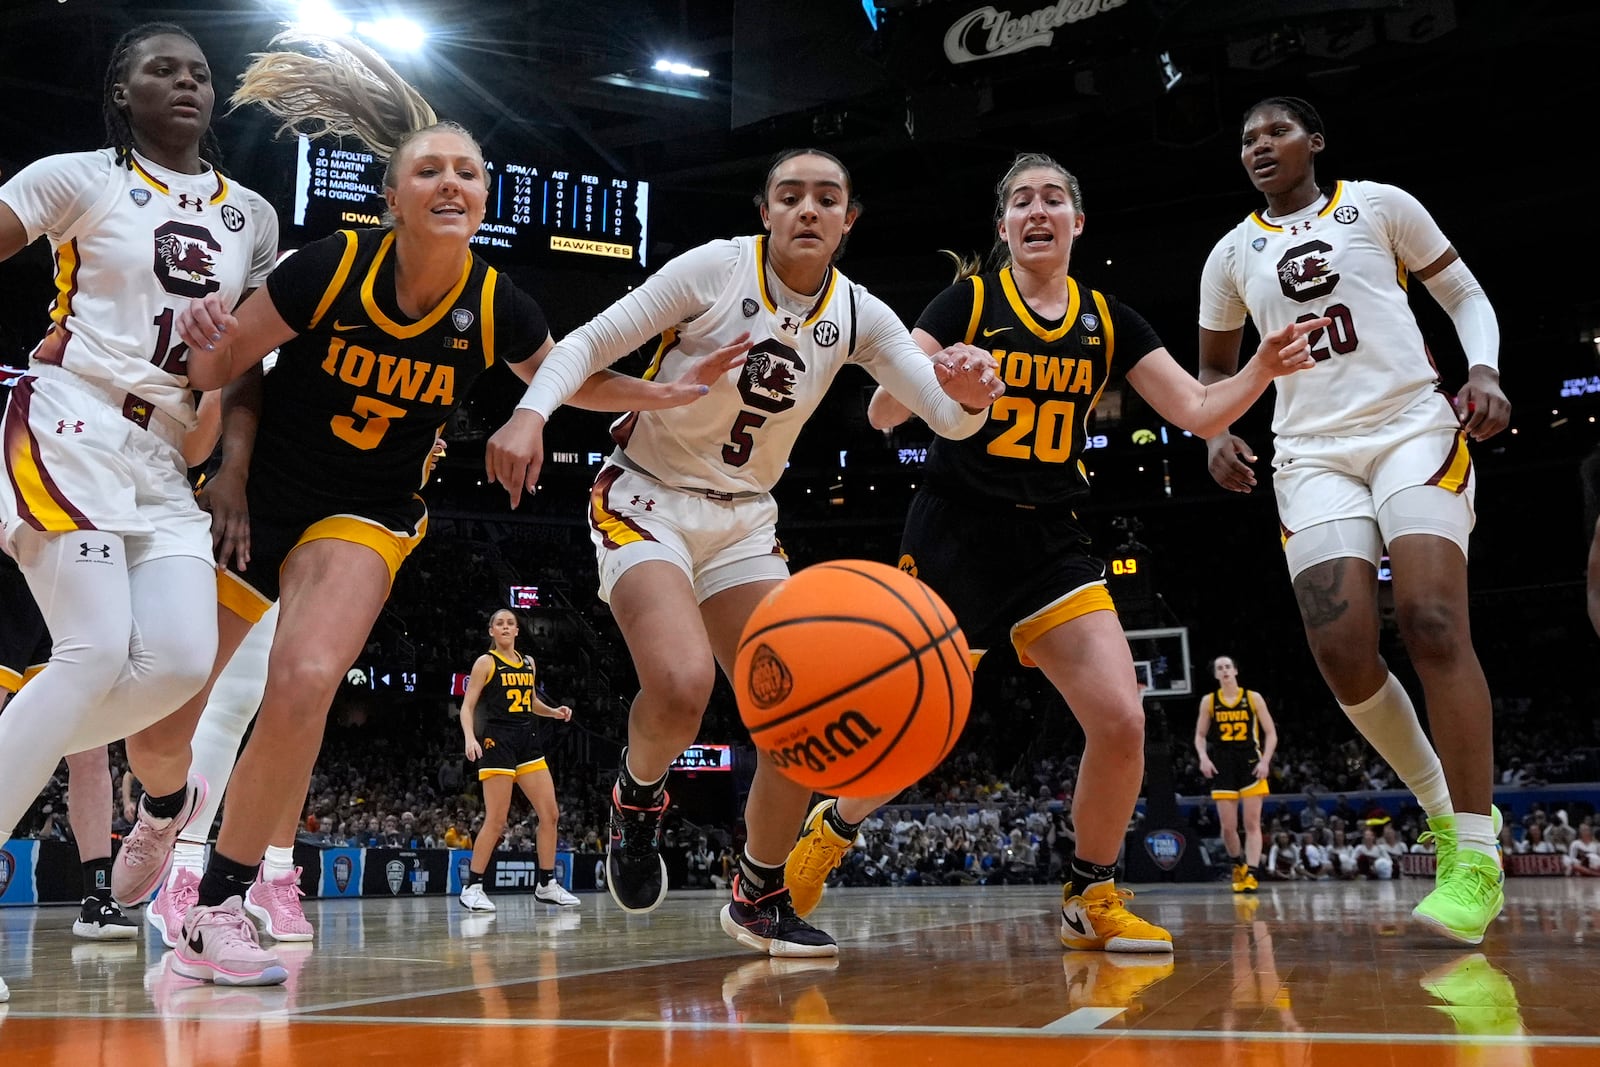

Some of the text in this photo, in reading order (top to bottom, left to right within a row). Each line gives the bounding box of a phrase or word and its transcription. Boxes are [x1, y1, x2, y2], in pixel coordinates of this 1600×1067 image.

[315, 157, 365, 172] 20 MARTIN
[319, 148, 373, 163] 3 AFFOLTER
[315, 167, 359, 181] 22 CLARK
[506, 164, 538, 177] 3PM/A
[551, 171, 569, 180] AST
[581, 174, 599, 185] REB
[612, 179, 628, 189] FLS
[313, 187, 367, 202] 44 O'GRADY
[314, 177, 377, 194] 24 MARSHALL
[514, 175, 623, 198] 1/3 3 2 2
[514, 185, 621, 207] 1/4 0 5 1
[513, 204, 622, 226] 1/2 1 3 0
[555, 200, 563, 209] 4
[585, 204, 592, 213] 6
[614, 208, 622, 217] 0
[1335, 209, 1357, 222] SEC
[222, 209, 243, 229] SEC
[342, 212, 380, 225] IOWA
[511, 213, 621, 236] 0/0 1 1 2
[492, 237, 513, 248] BALL.
[552, 240, 631, 256] HAWKEYES
[816, 323, 838, 344] SEC
[1296, 303, 1359, 362] 20
[321, 337, 455, 405] IOWA
[992, 349, 1092, 395] IOWA
[330, 395, 407, 450] 3
[987, 396, 1075, 463] 20
[721, 410, 767, 467] 5
[1112, 558, 1137, 575] 0.9
[402, 672, 417, 684] 1.1
[501, 673, 535, 687] IOWA
[405, 684, 414, 693] 30
[506, 688, 533, 713] 24
[1216, 709, 1250, 722] IOWA
[1219, 722, 1248, 741] 22
[495, 861, 535, 887] ESPN
